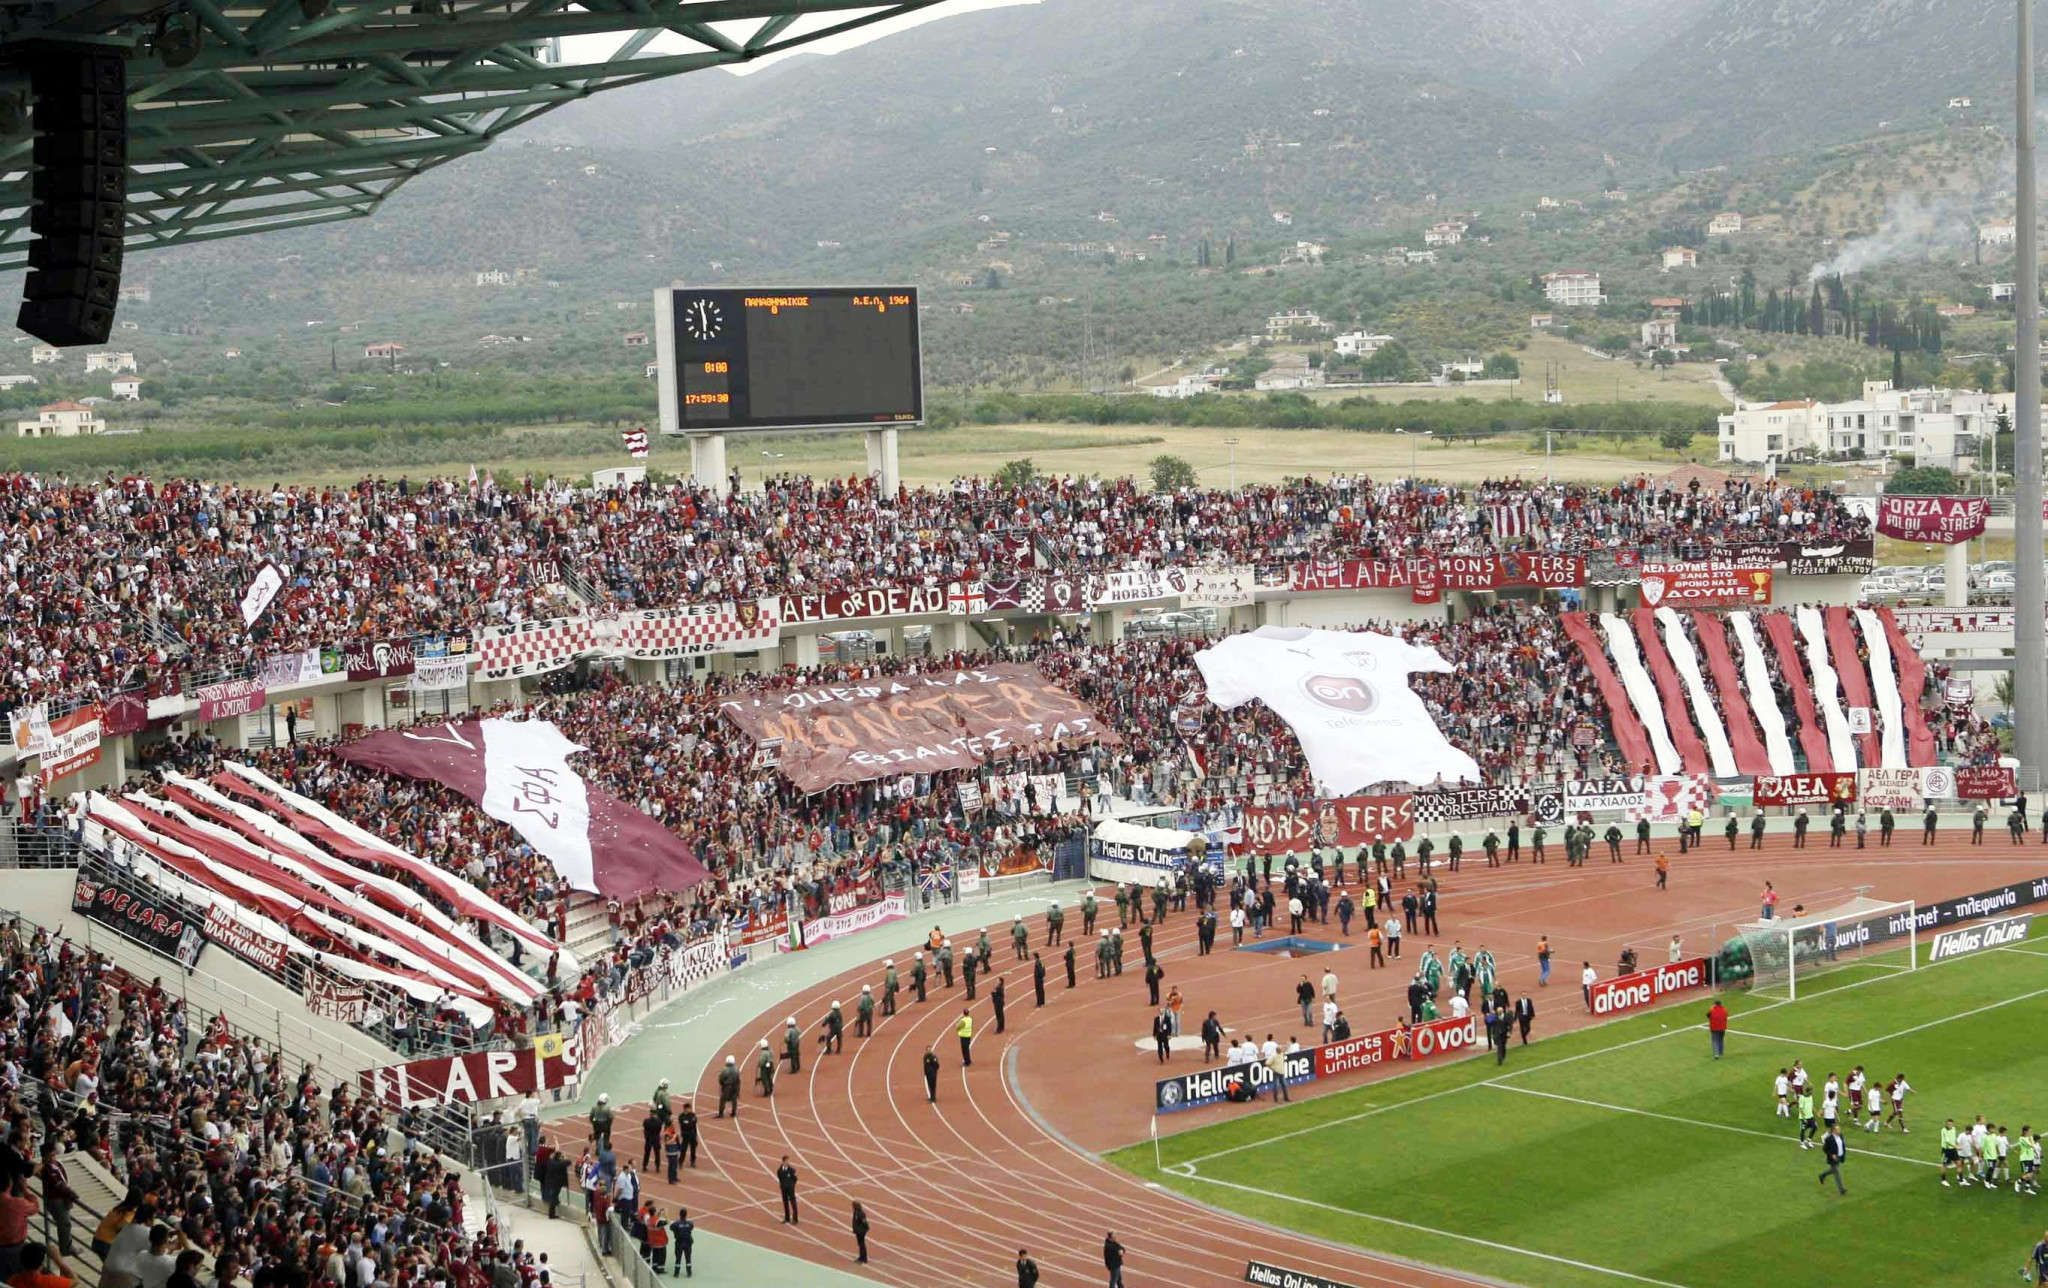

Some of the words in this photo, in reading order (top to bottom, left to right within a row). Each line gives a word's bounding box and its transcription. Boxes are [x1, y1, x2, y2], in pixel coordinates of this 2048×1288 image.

[889, 296, 909, 305] 1964
[1882, 497, 1943, 516] FORZA
[1886, 512, 1920, 530] VOLOU
[1940, 514, 1981, 531] STREET
[1905, 530, 1954, 542] FANS
[1440, 557, 1495, 573] MONS
[1528, 556, 1575, 569] TERS
[1816, 556, 1844, 567] FANS
[1444, 573, 1492, 587] TIRN
[1527, 571, 1575, 583] AVOS
[1112, 586, 1163, 600] HORSES
[783, 595, 839, 622] AEL
[868, 586, 943, 616] DEAD
[487, 664, 525, 679] WE
[634, 643, 715, 657] COMING
[1415, 788, 1497, 806] MONSTERS
[1443, 799, 1517, 817] ORESTIADA
[1245, 807, 1310, 844] MONS
[1346, 798, 1412, 833] TERS
[1102, 840, 1134, 860] Hellas
[77, 884, 95, 899] STOP
[100, 888, 183, 938] AELARA
[1889, 906, 1938, 935] internet
[1956, 888, 2016, 917] τηλεφωνία
[1940, 933, 1980, 957] Hellas
[1983, 920, 2026, 948] OnLine
[1595, 982, 1650, 1014] afone
[1438, 1016, 1477, 1049] vod
[1324, 1036, 1382, 1060] sports
[1250, 1056, 1309, 1086] Onine
[1325, 1050, 1382, 1074] united
[1250, 1265, 1282, 1287] Hellas
